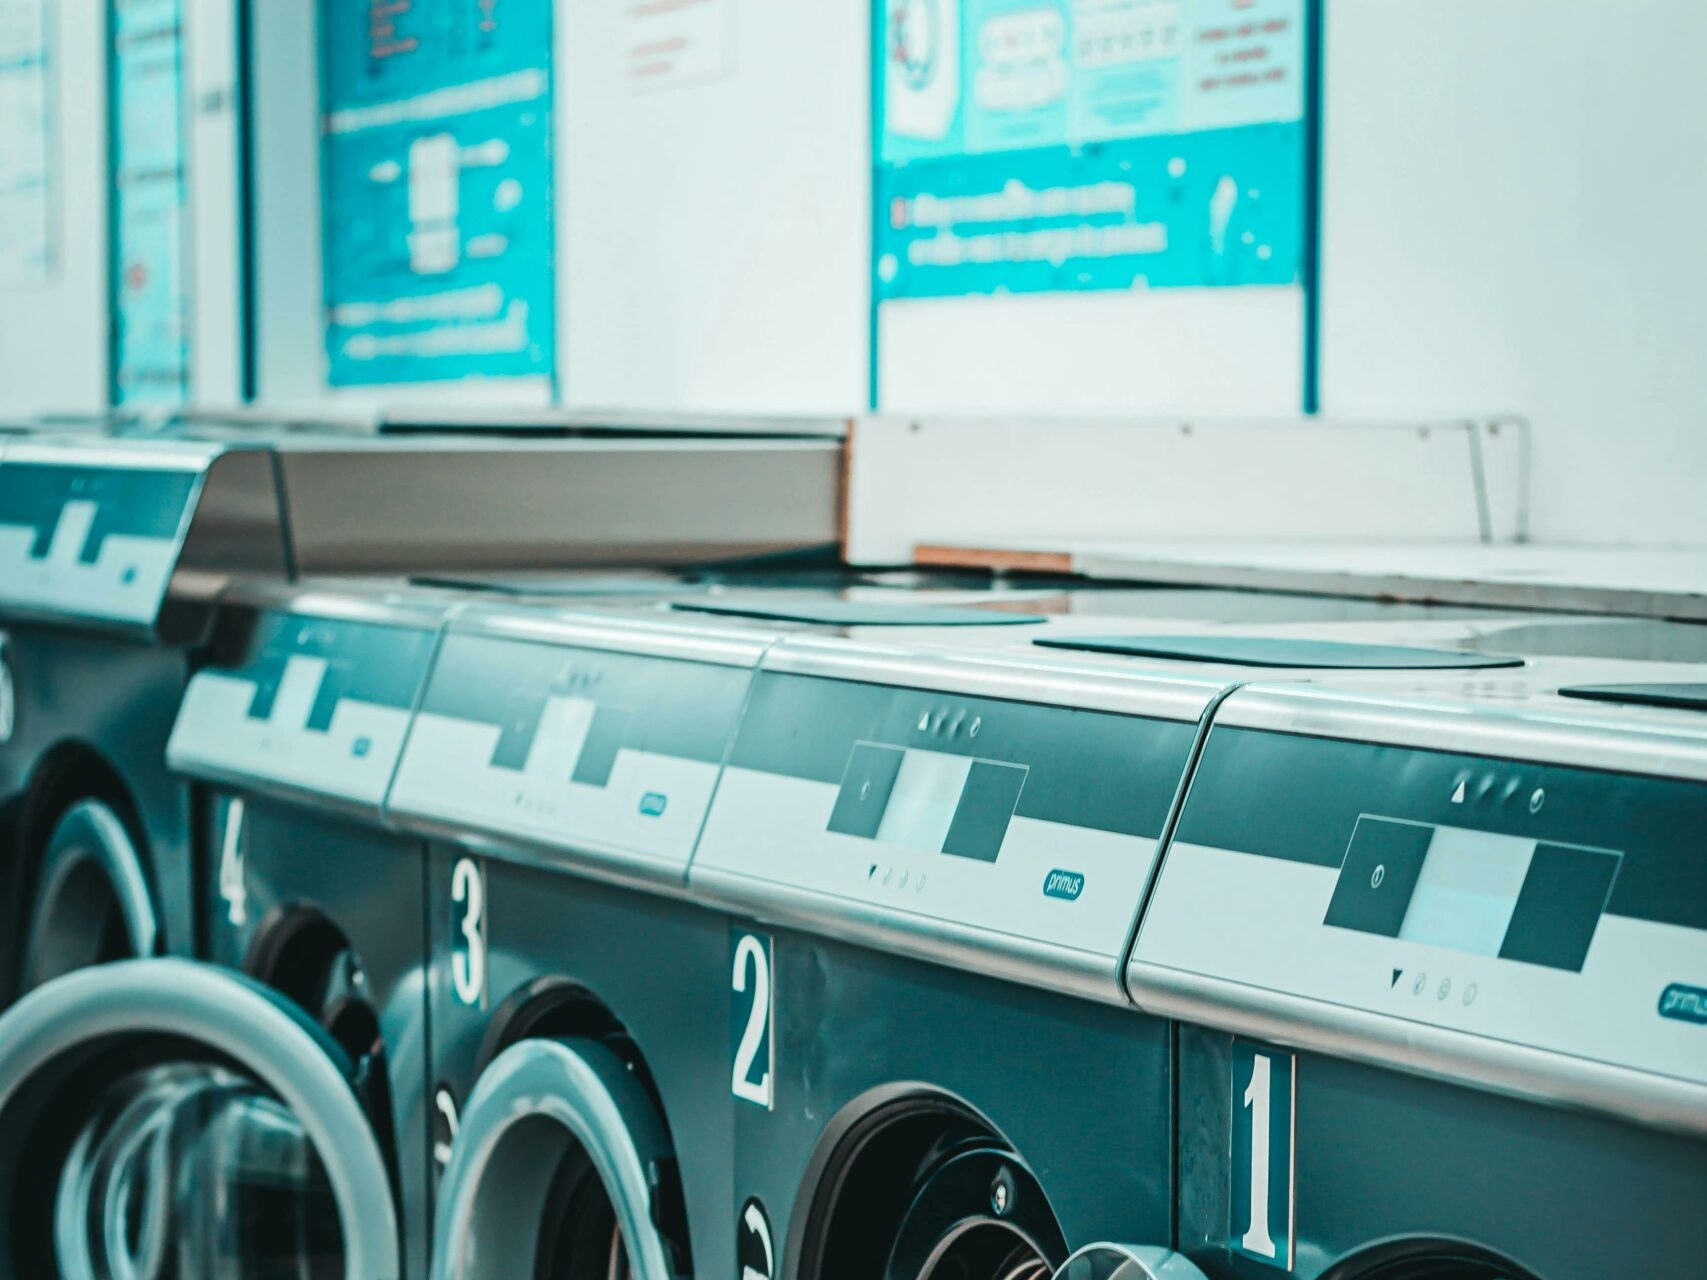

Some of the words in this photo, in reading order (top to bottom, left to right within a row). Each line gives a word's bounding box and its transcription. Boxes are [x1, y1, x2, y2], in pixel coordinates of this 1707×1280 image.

[220, 799, 246, 926] 4
[452, 858, 484, 1004] 3
[1046, 871, 1081, 895] primus
[732, 934, 769, 1106] 2
[1243, 1053, 1275, 1259] 1
